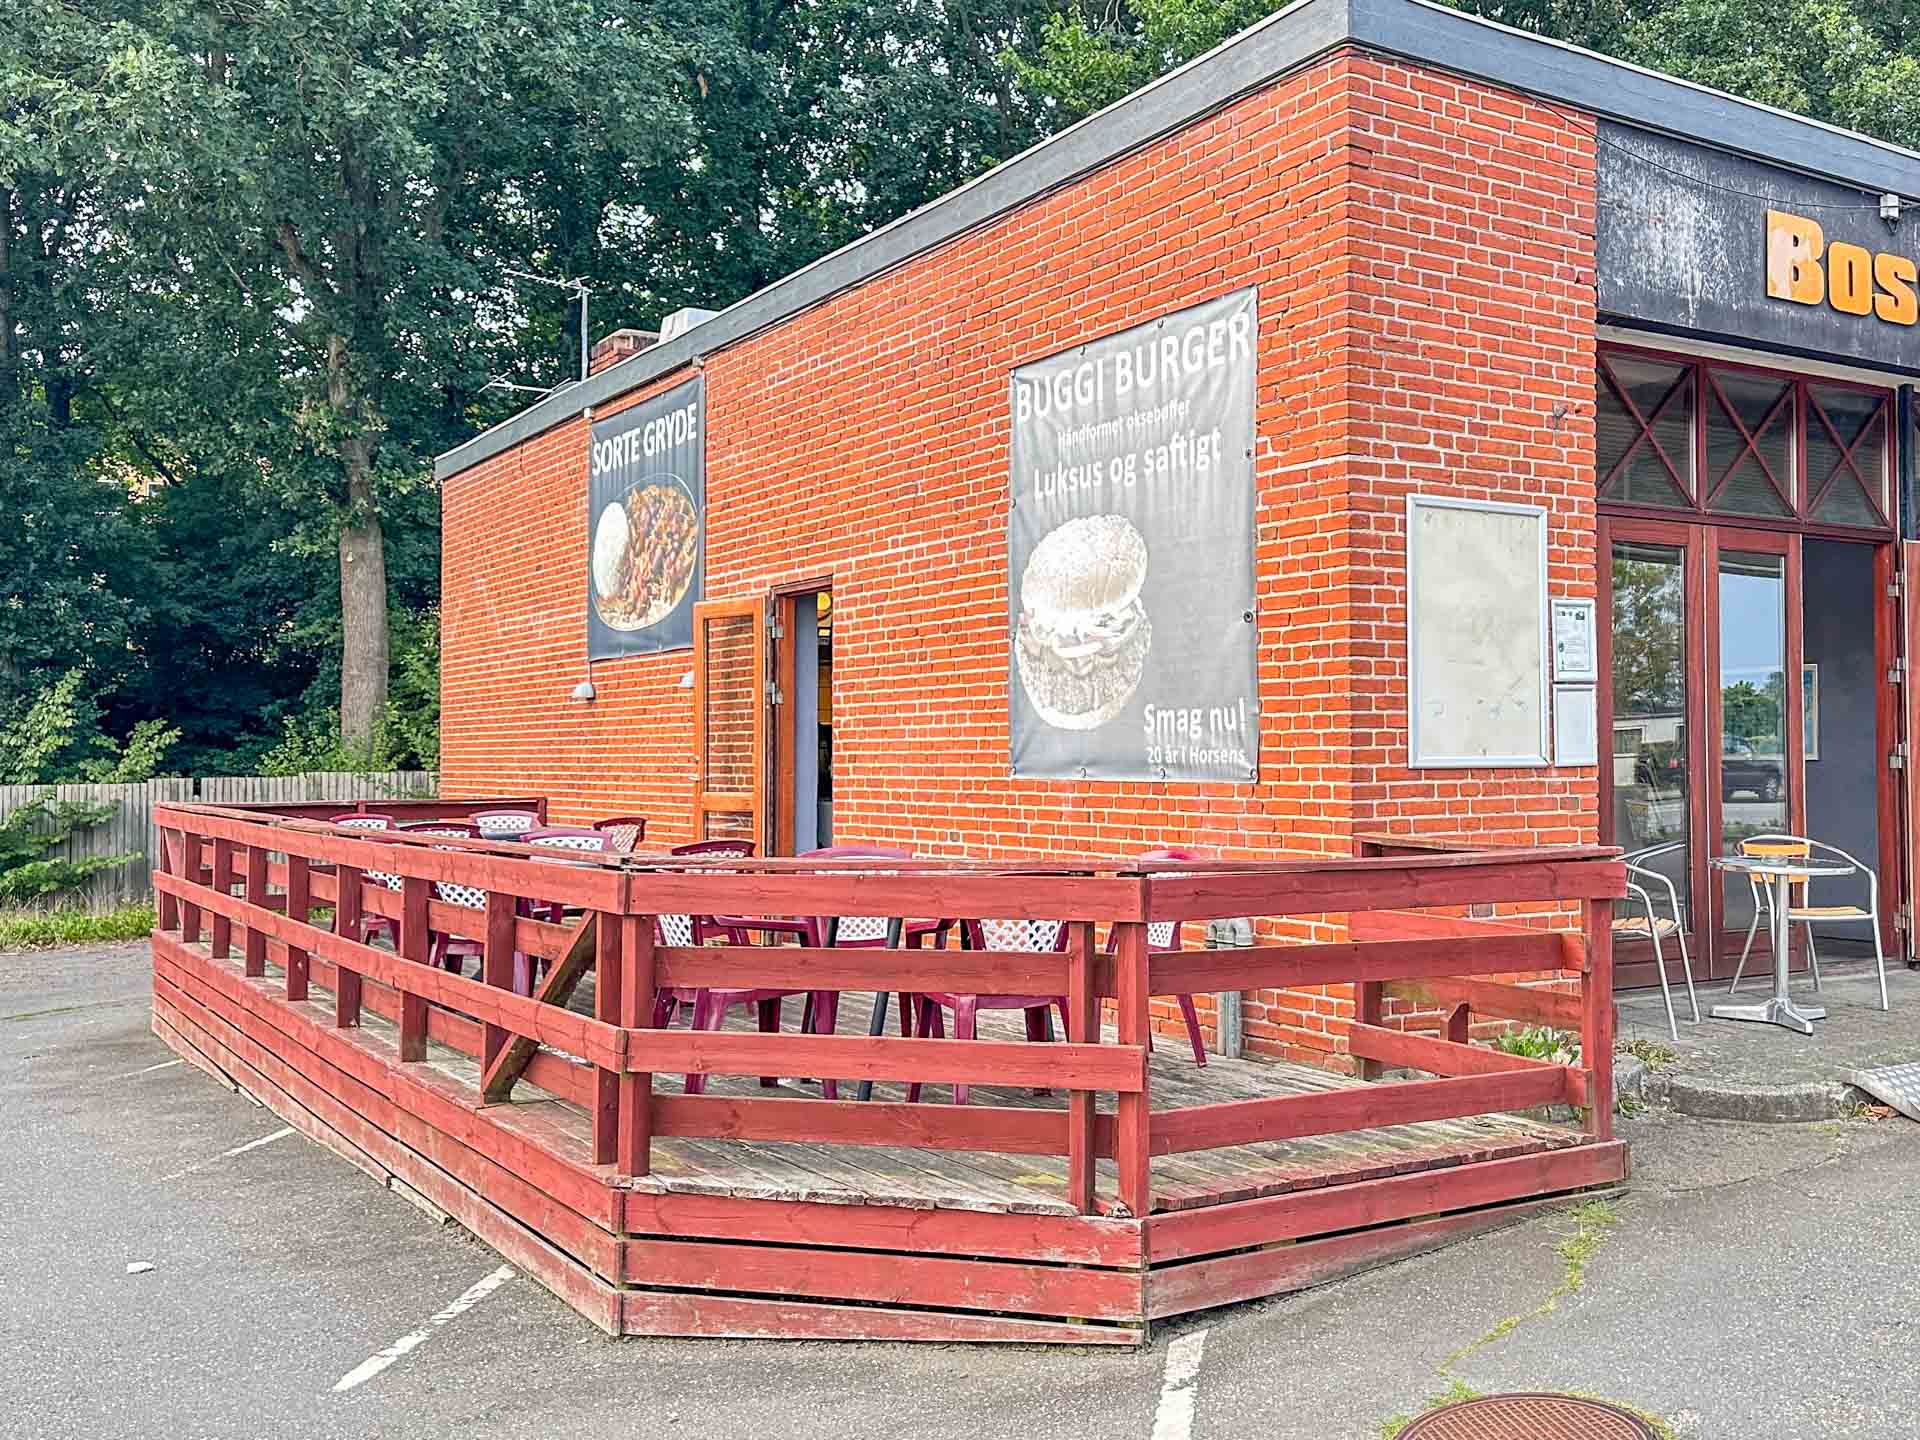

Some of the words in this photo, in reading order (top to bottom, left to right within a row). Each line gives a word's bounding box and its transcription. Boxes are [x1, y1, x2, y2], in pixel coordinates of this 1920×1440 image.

[1016, 358, 1104, 424] BUGGI
[1115, 313, 1251, 395] BURGER
[592, 427, 640, 477] SORTE
[643, 402, 697, 457] GRYDE
[1034, 461, 1102, 500] Luksus
[1109, 453, 1136, 487] og
[1144, 427, 1222, 476] saftigt
[1143, 703, 1202, 739] Smag
[1210, 696, 1246, 733] nu!
[1146, 746, 1162, 764] 20
[1165, 744, 1179, 764] år
[1190, 745, 1246, 765] Horsens
